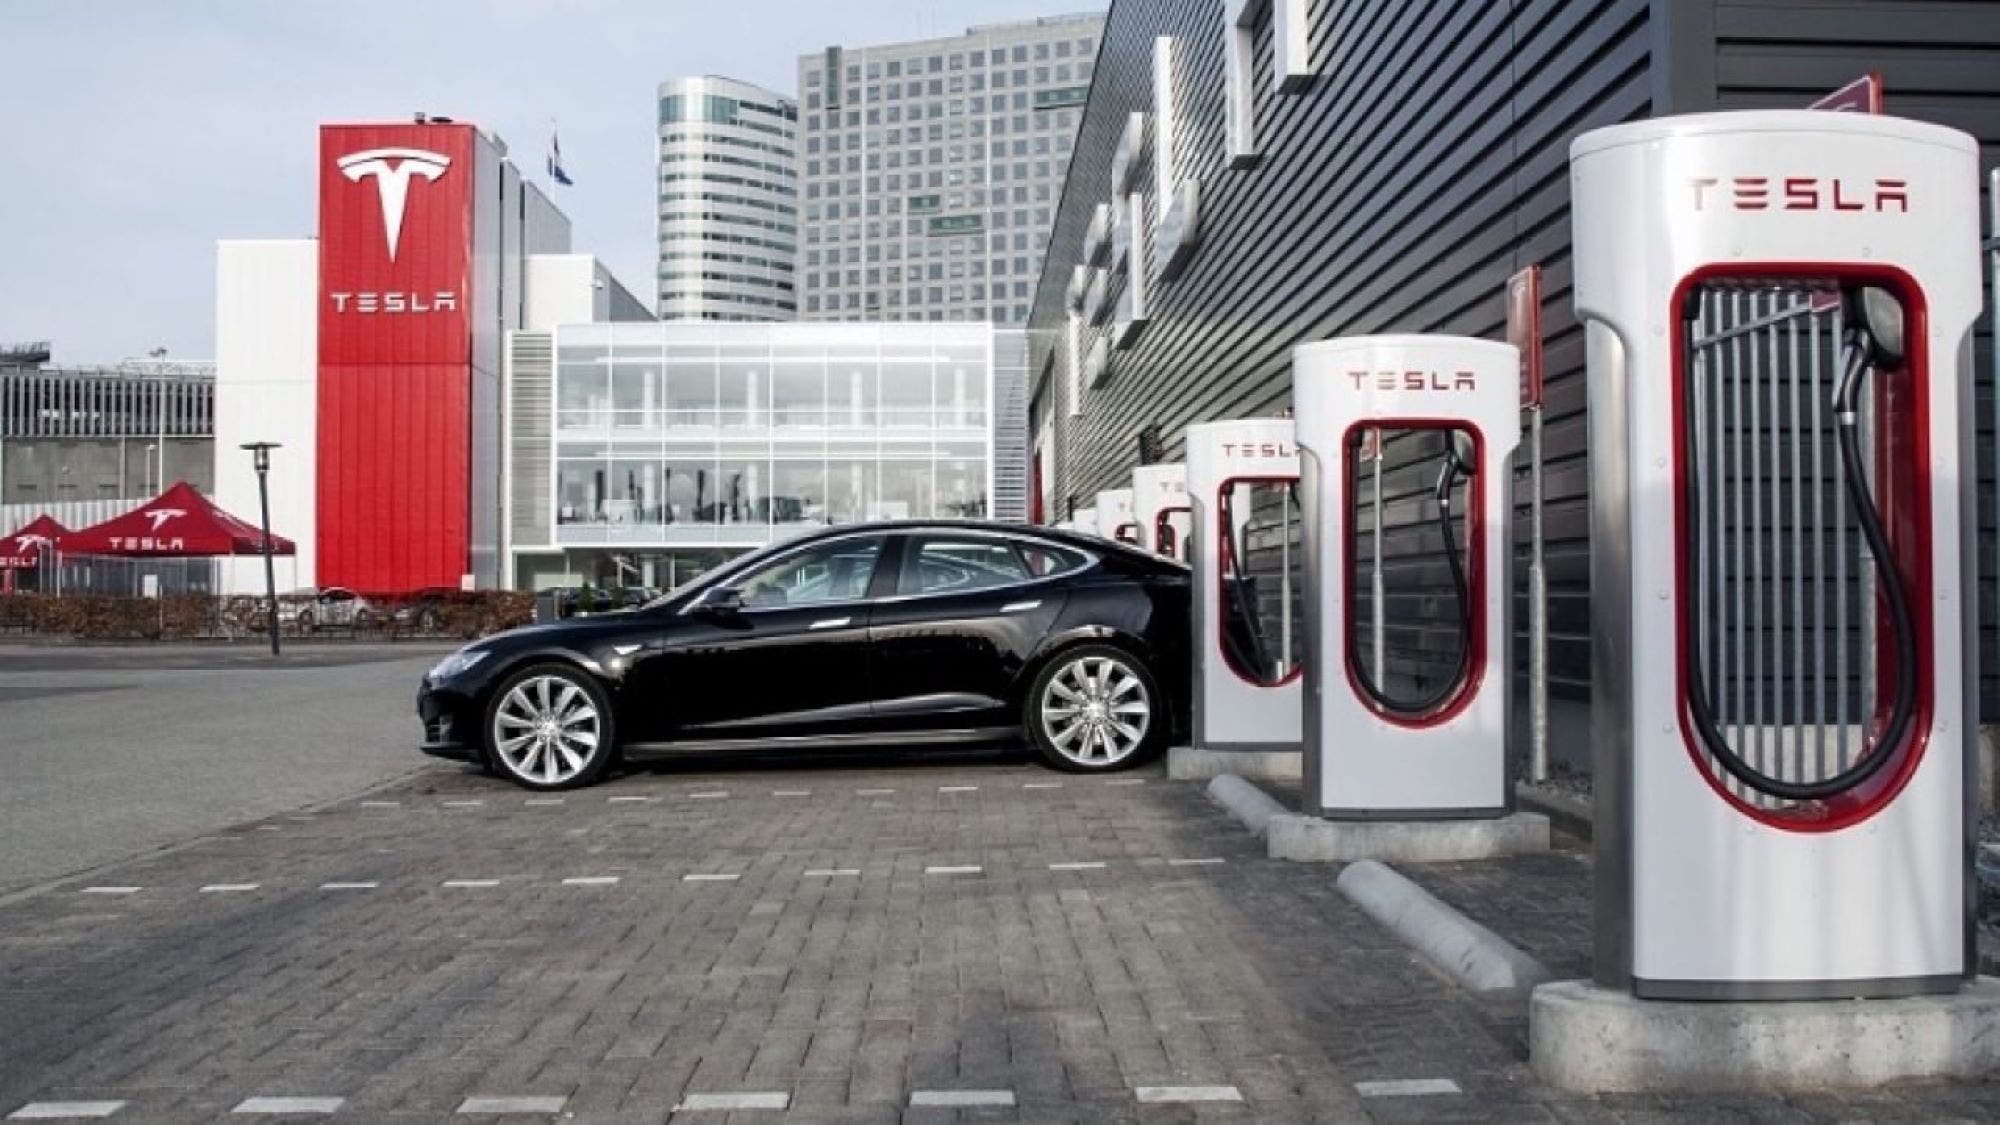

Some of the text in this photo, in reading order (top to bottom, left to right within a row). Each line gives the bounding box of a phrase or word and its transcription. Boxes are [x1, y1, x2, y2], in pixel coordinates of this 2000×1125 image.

[1688, 178, 1908, 212] TESLA
[330, 291, 456, 313] TESLA
[1348, 370, 1476, 391] TESLA
[109, 537, 184, 550] TESLA
